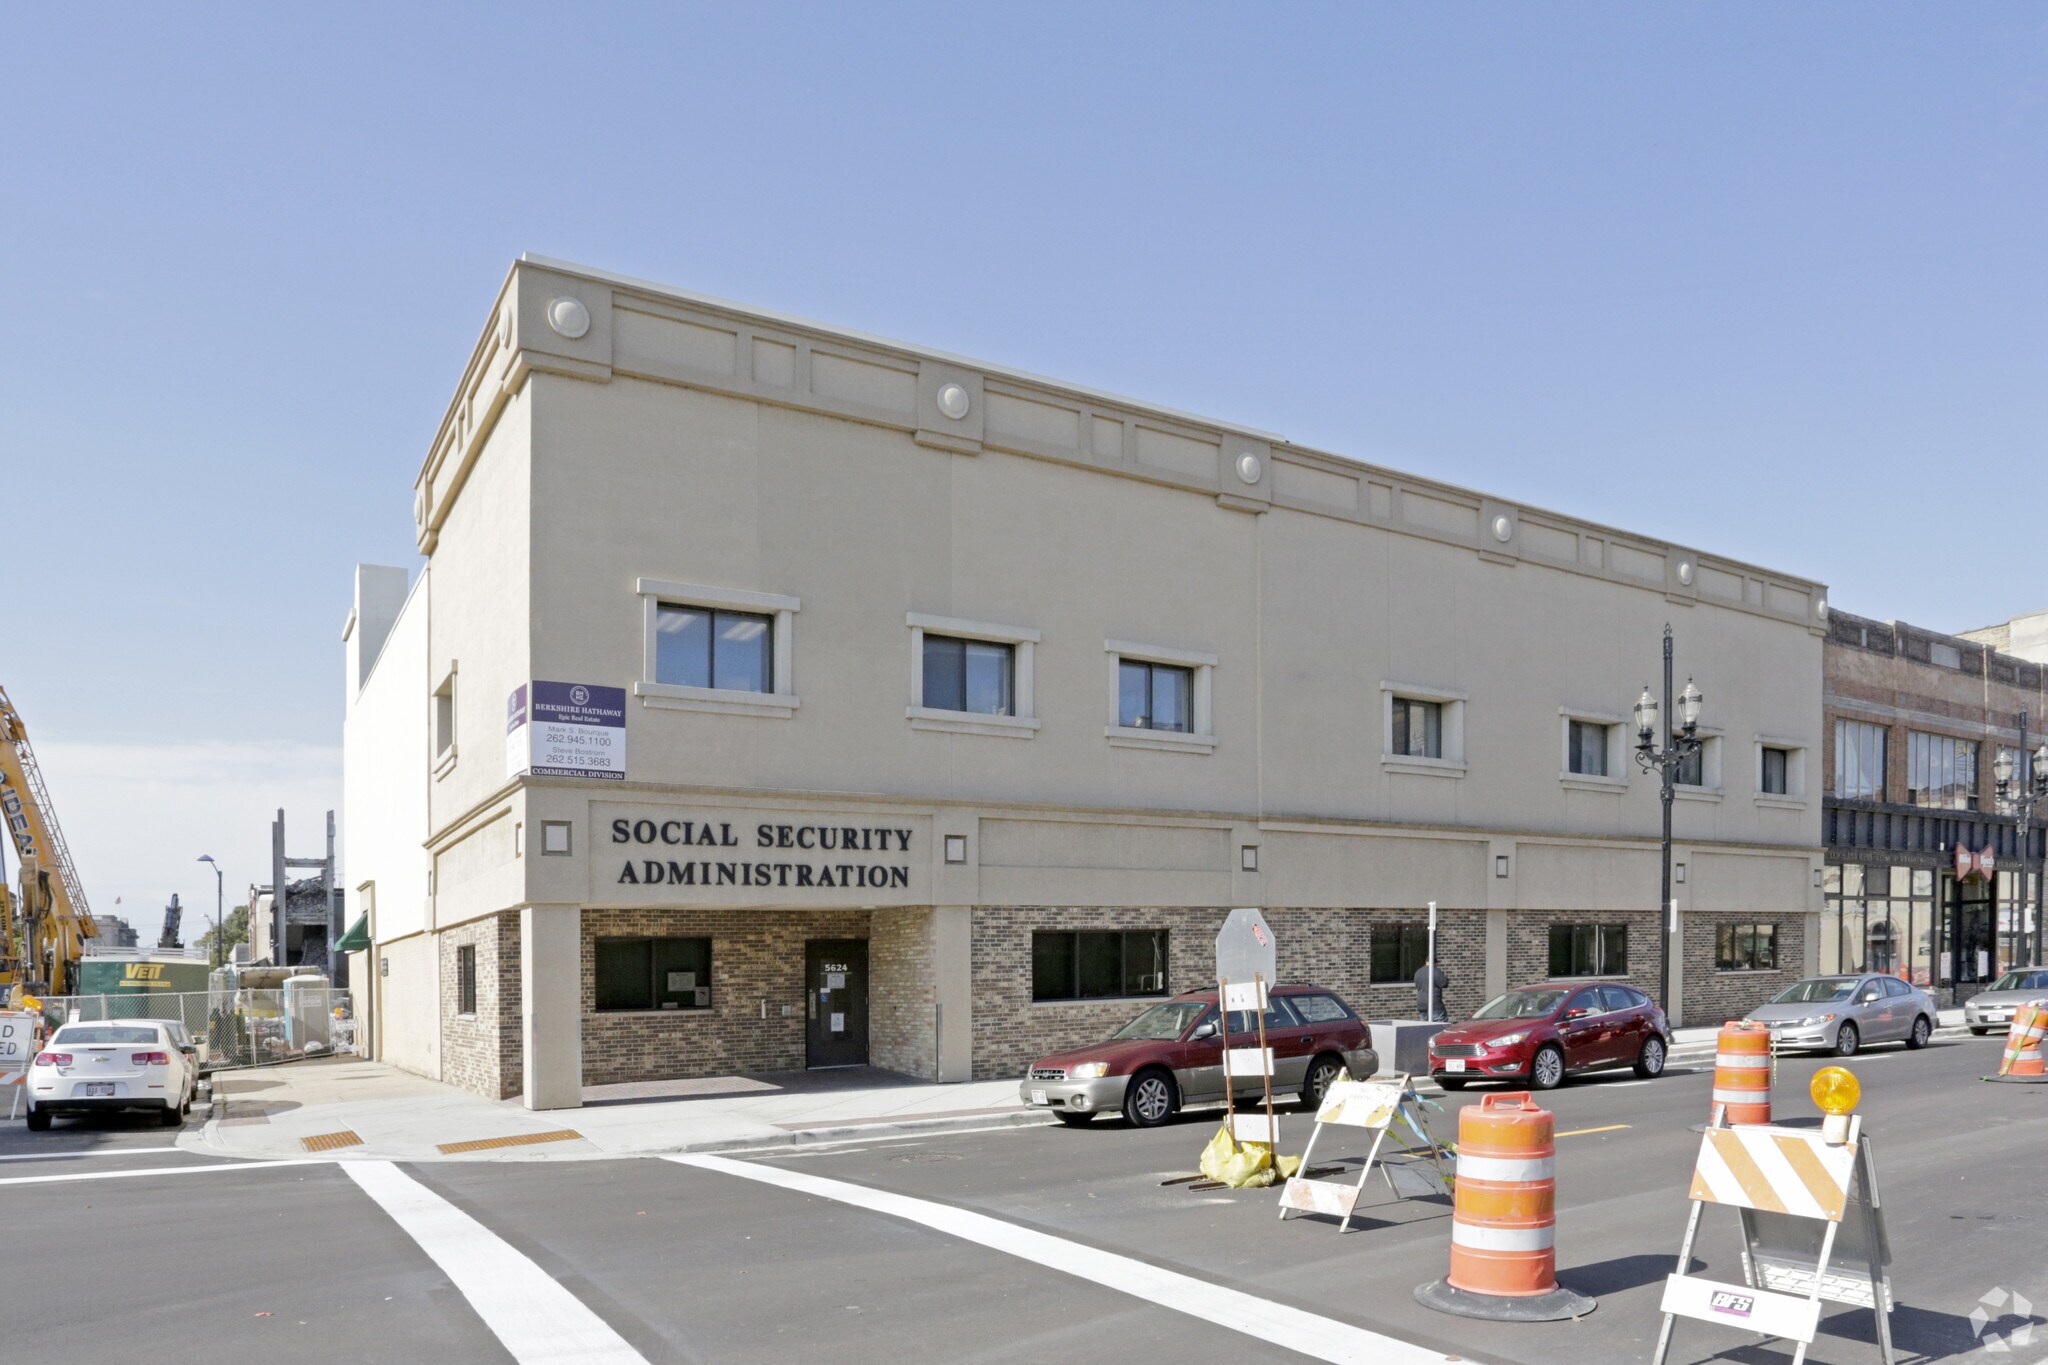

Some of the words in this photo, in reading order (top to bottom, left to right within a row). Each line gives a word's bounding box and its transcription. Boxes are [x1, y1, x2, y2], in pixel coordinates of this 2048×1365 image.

[535, 704, 580, 713] BERKSHIRE
[582, 707, 622, 717] HATHAWAY
[578, 728, 609, 736] Bourque
[546, 734, 611, 746] 262.945.1100
[575, 748, 605, 756] Bostrom
[546, 755, 611, 767] 262.515.3683
[532, 768, 587, 777] COMMERCIAL
[1, 788, 37, 855] IDEA
[612, 819, 738, 846] SOCIAL
[757, 824, 913, 850] SECURITY
[617, 860, 909, 888] ADMINISTRATION
[125, 963, 165, 979] VEIT
[1712, 1292, 1753, 1311] BFS
